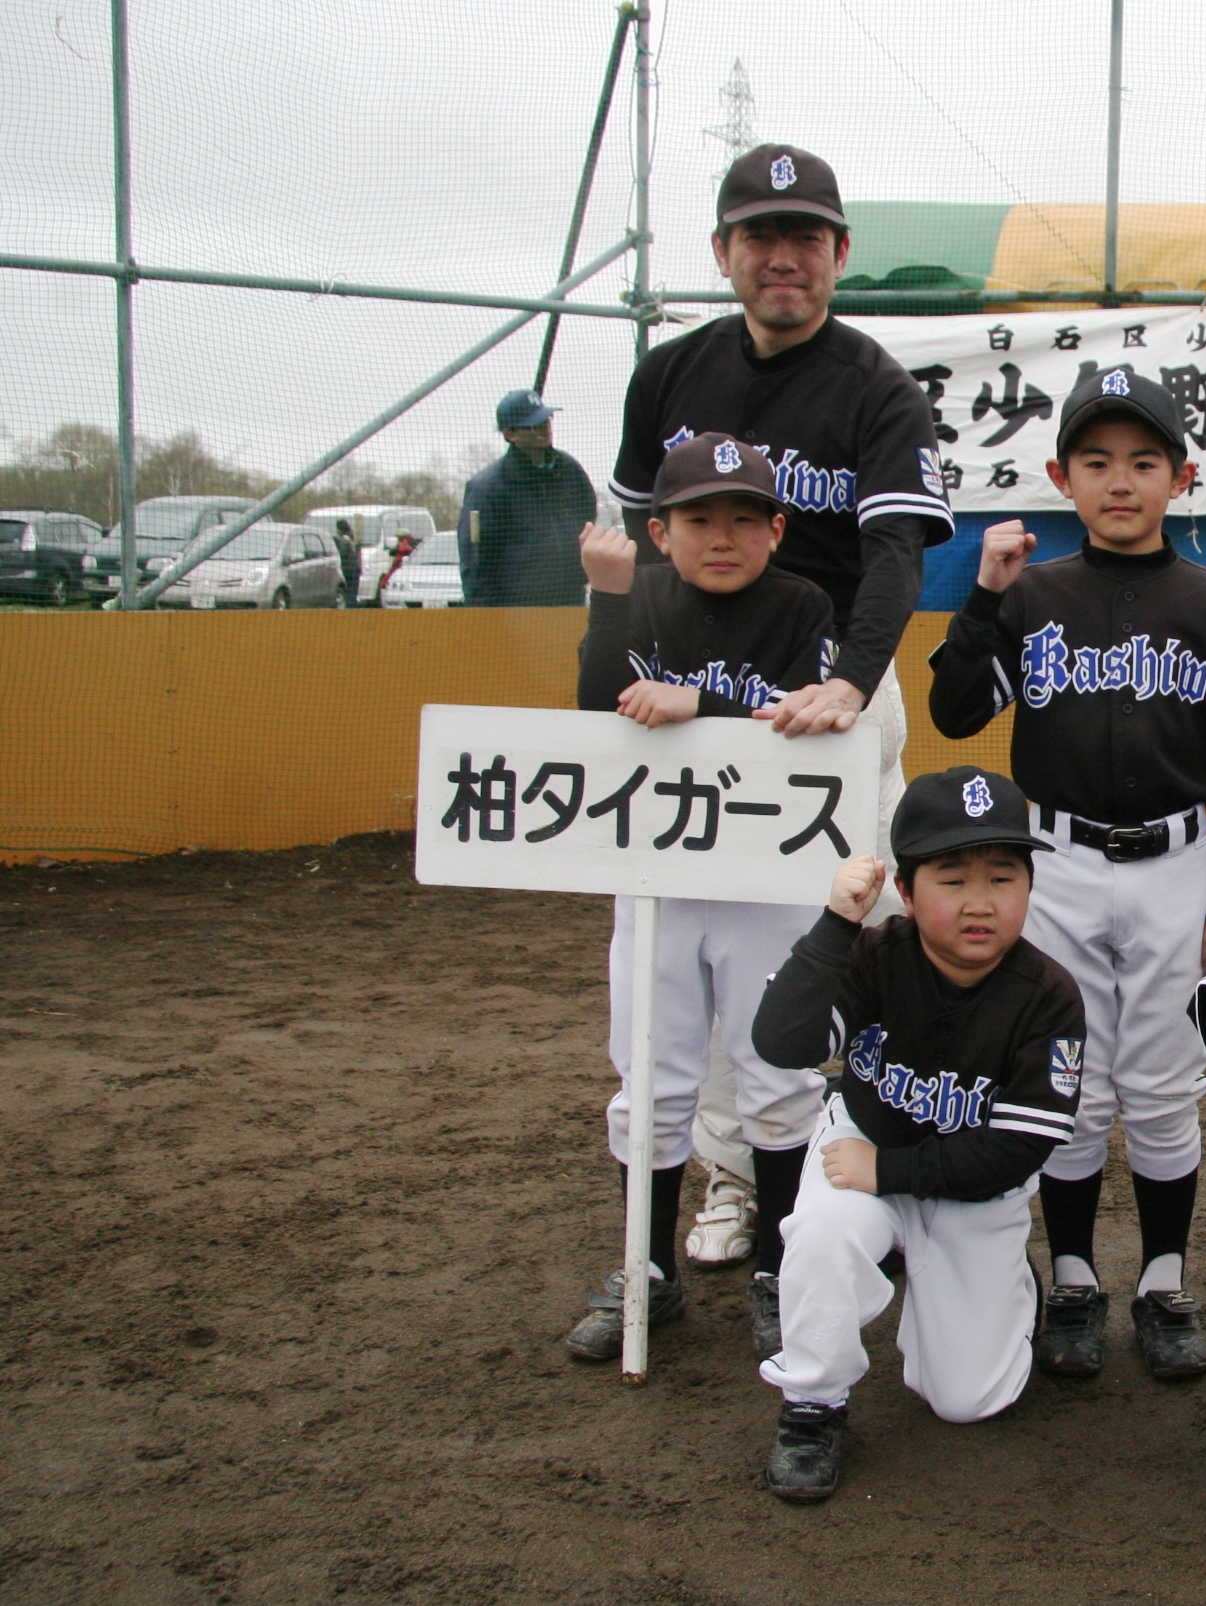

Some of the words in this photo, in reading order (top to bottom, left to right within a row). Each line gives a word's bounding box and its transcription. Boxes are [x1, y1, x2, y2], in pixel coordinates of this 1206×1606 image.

[441, 752, 851, 859] 柏タイガース
